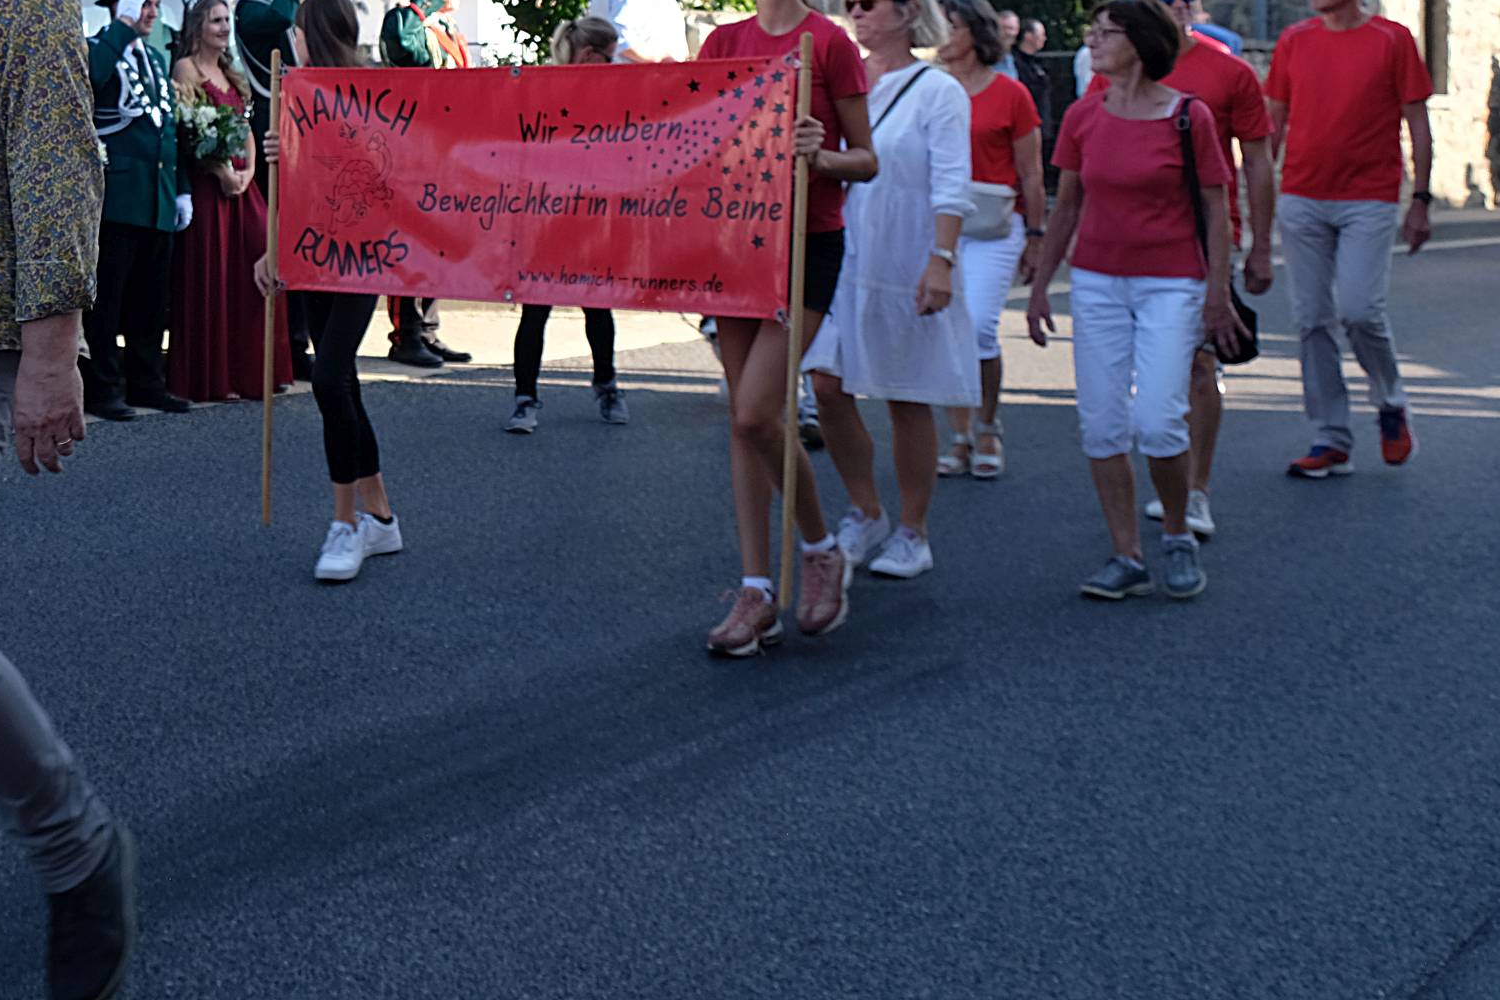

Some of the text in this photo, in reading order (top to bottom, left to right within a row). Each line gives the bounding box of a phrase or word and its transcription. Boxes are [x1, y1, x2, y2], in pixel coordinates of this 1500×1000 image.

[288, 83, 418, 137] HAMICH
[518, 110, 683, 144] Wir zaubern
[417, 181, 784, 231] Beweglichkeit in müde Beine
[293, 226, 409, 278] RUNNERS
[518, 264, 724, 293] www.hamich-runners.de
